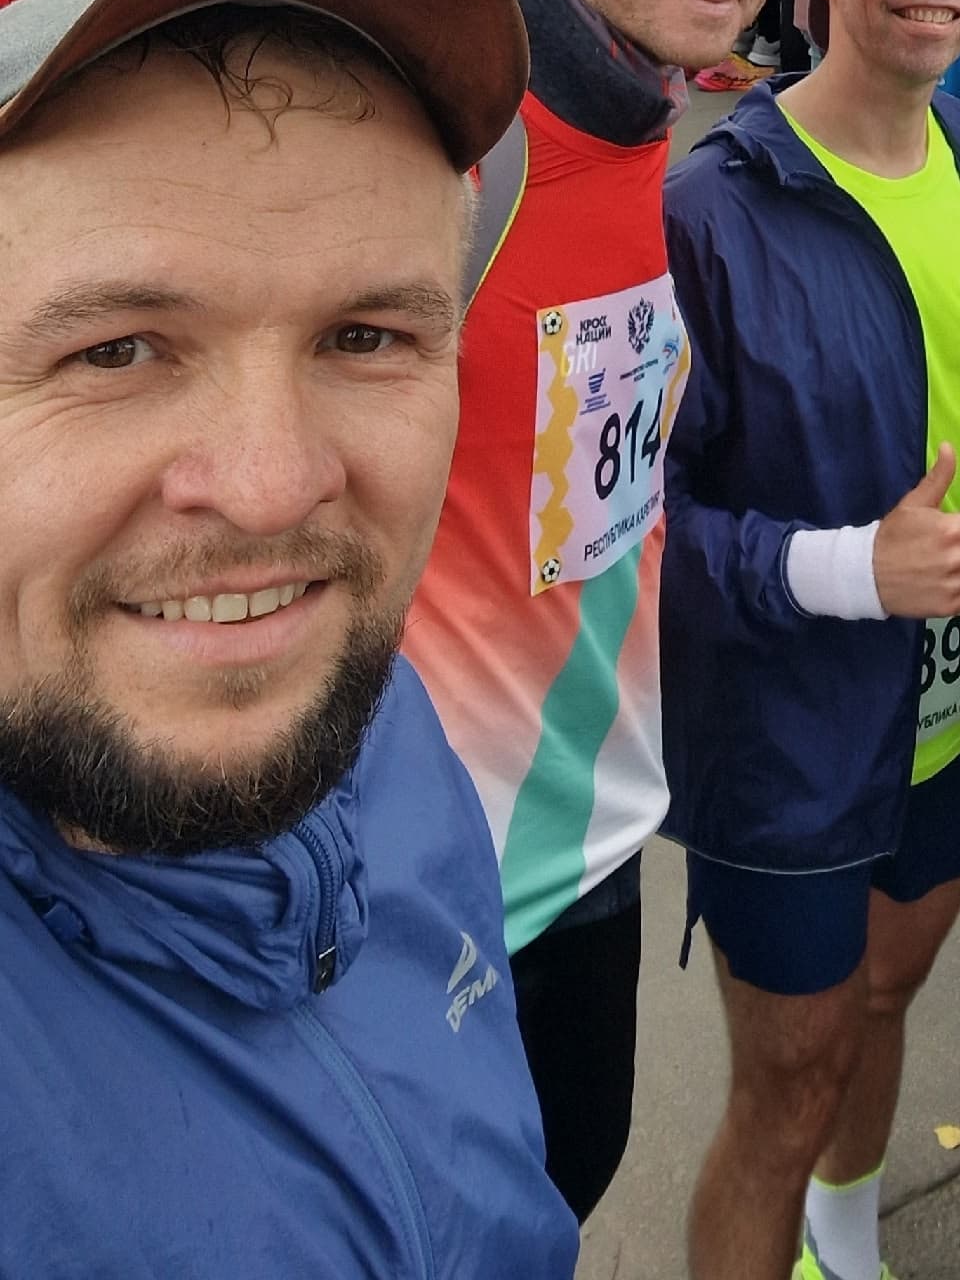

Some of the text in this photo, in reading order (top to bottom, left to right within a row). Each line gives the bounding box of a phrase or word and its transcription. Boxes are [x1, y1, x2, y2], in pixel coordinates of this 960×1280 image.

[580, 316, 607, 332] КРОСС
[576, 326, 612, 346] НАЦИИ
[594, 388, 664, 501] 814
